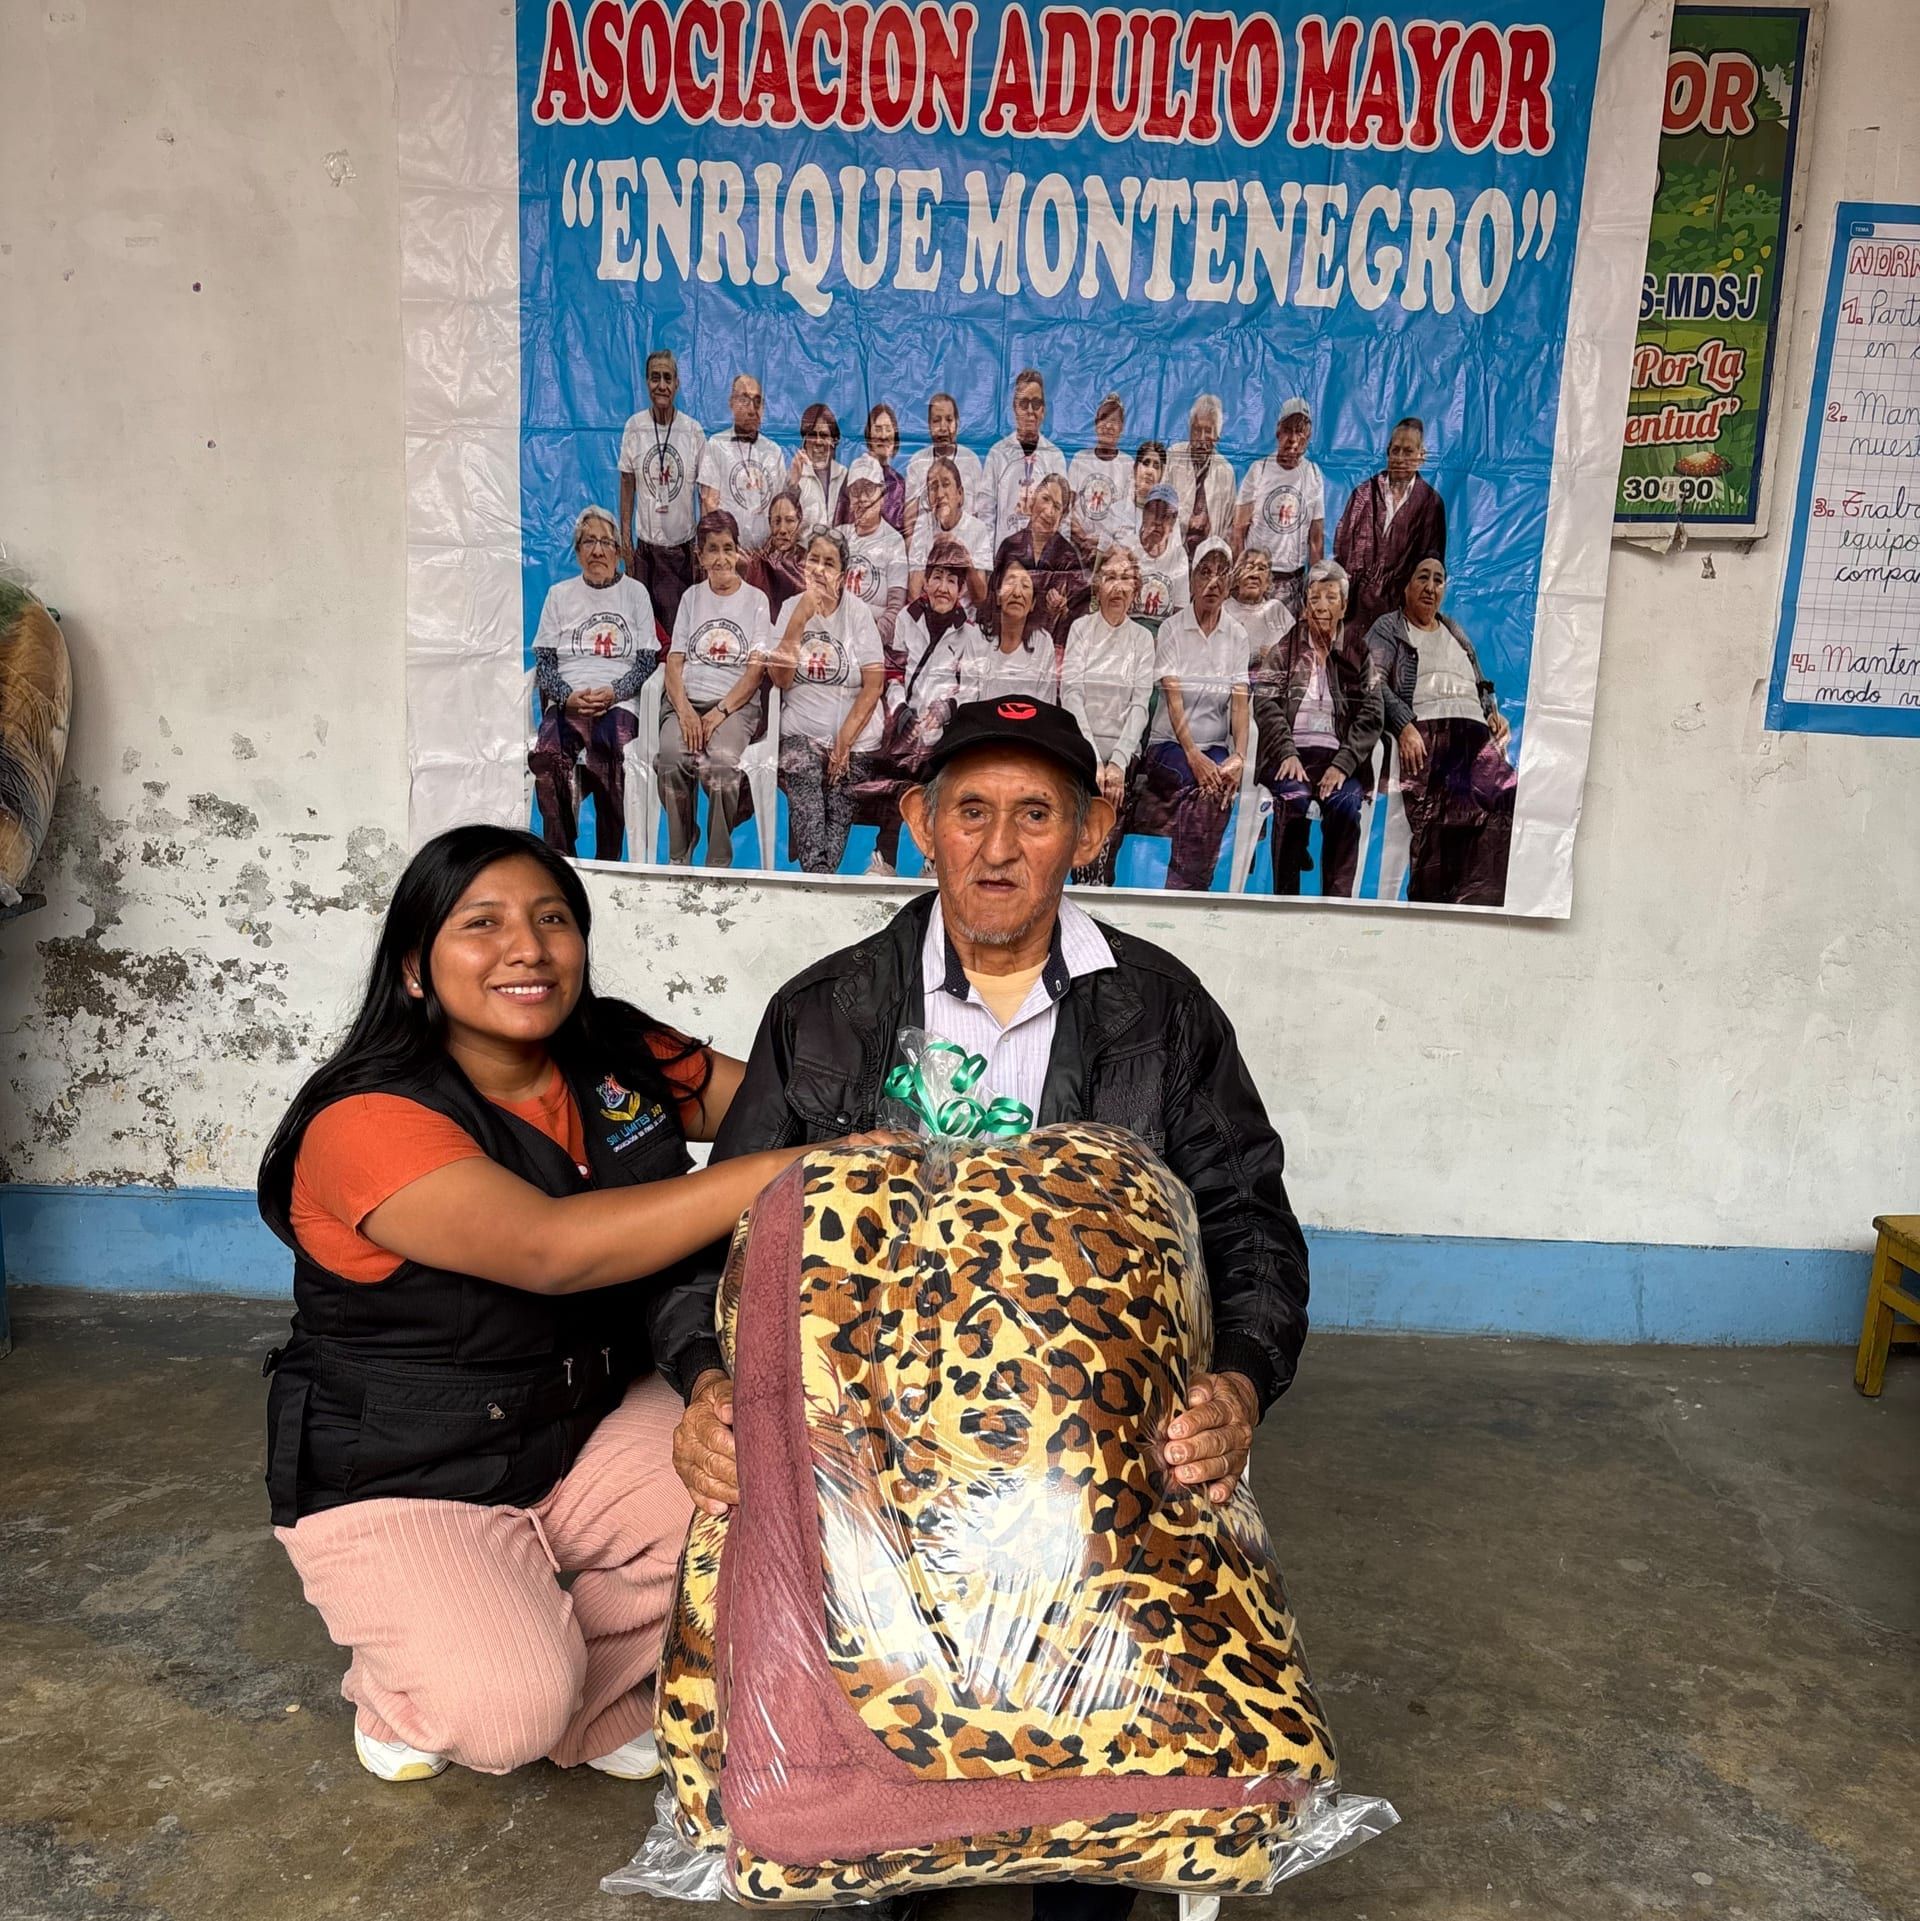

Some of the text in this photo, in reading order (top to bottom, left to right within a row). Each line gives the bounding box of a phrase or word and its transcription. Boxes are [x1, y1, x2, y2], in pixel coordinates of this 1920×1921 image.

[532, 0, 1556, 155] ASOCIACION ADULTO MAYOR
[1662, 51, 1758, 135] OR
[562, 156, 1557, 317] “ENRIQUE MONTENEGRO”
[1639, 273, 1761, 321] S-MDSJ
[1868, 289, 1920, 327] Part
[1632, 341, 1743, 392] Por La
[1864, 341, 1897, 359] en
[1826, 402, 1848, 422] 2.
[1813, 498, 1835, 517] 3.
[1791, 653, 1816, 673] 4.
[1815, 680, 1882, 704] modo
